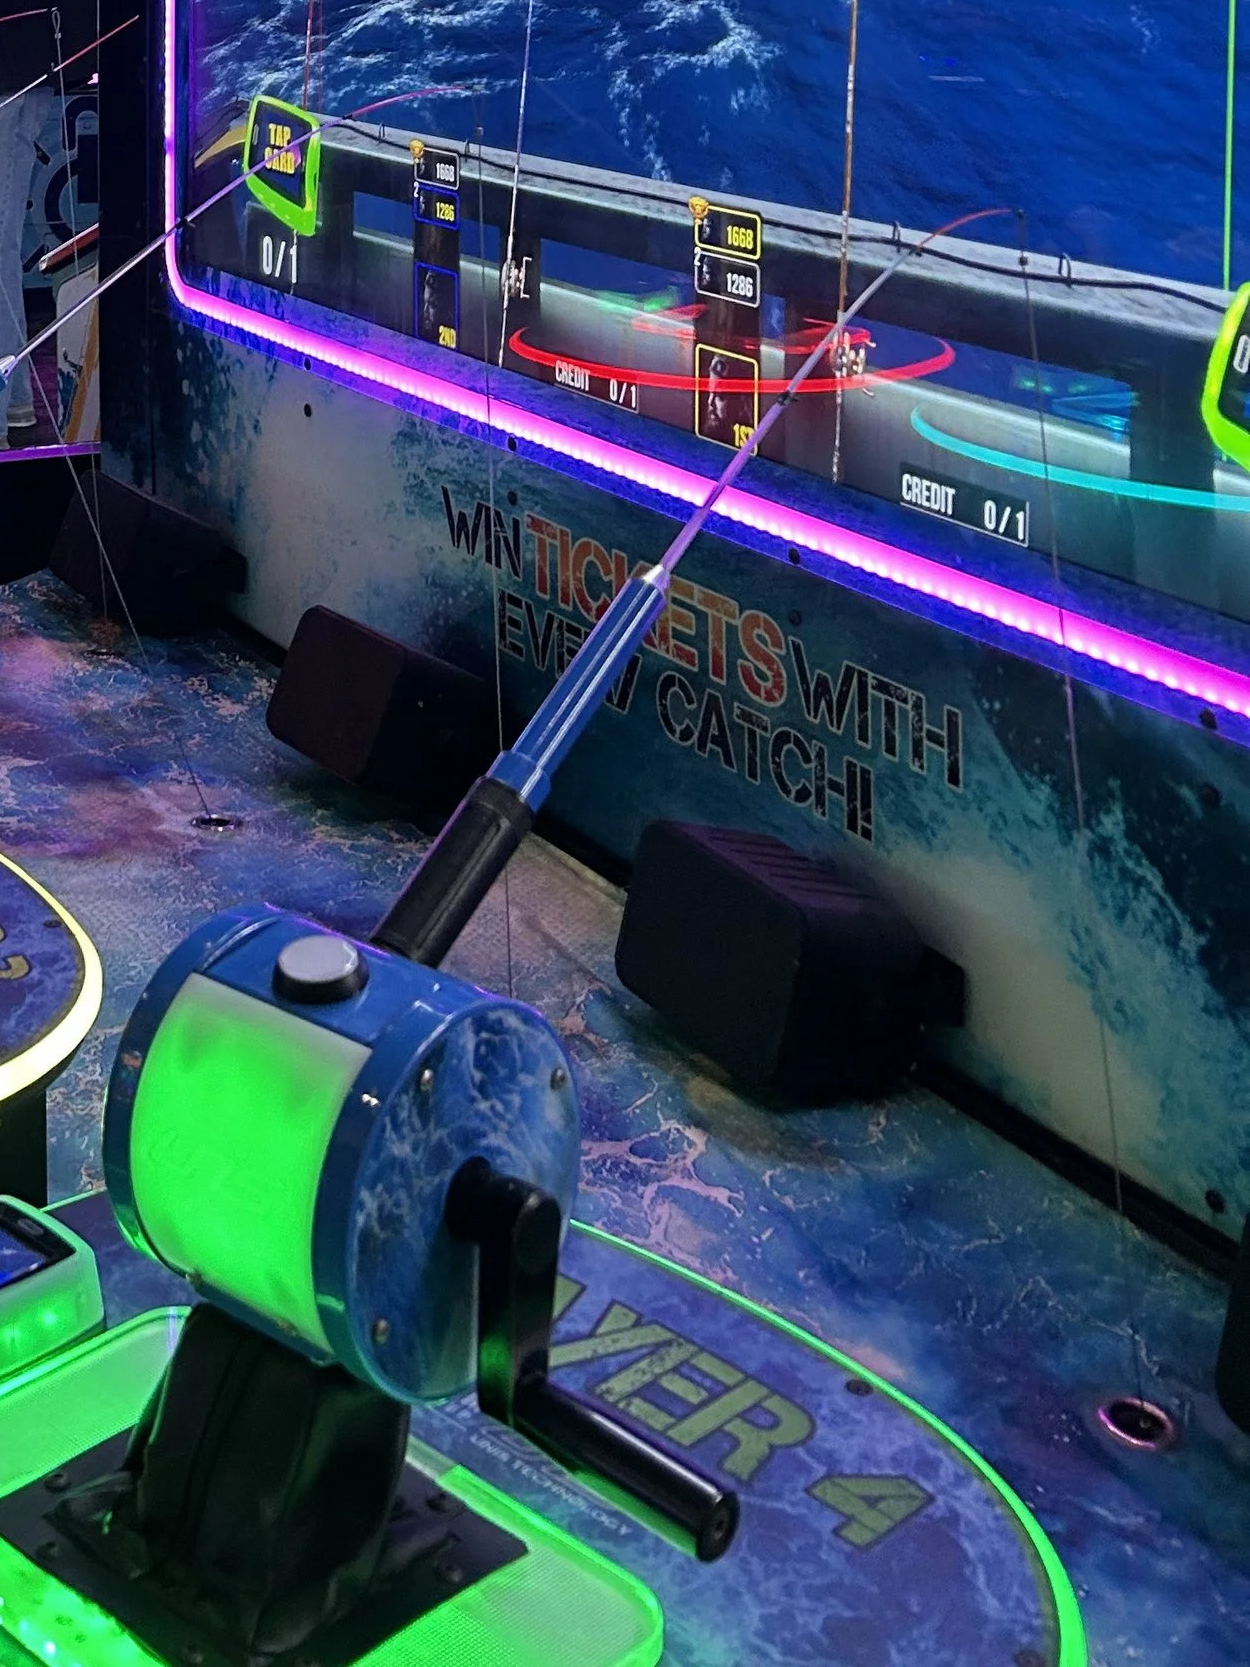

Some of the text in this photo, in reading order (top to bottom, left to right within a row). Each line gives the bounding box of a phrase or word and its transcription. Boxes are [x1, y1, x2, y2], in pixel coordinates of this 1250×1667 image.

[268, 122, 291, 147] TAP
[264, 146, 295, 175] CARD
[726, 225, 754, 250] 1668
[694, 246, 702, 267] 2
[726, 272, 754, 298] 1286
[555, 359, 591, 392] CREDIT
[901, 472, 957, 517] CREDIT
[440, 484, 523, 579] WIN
[786, 635, 963, 793] WITH
[655, 669, 875, 843] CATCH!
[805, 1473, 937, 1550] 4
